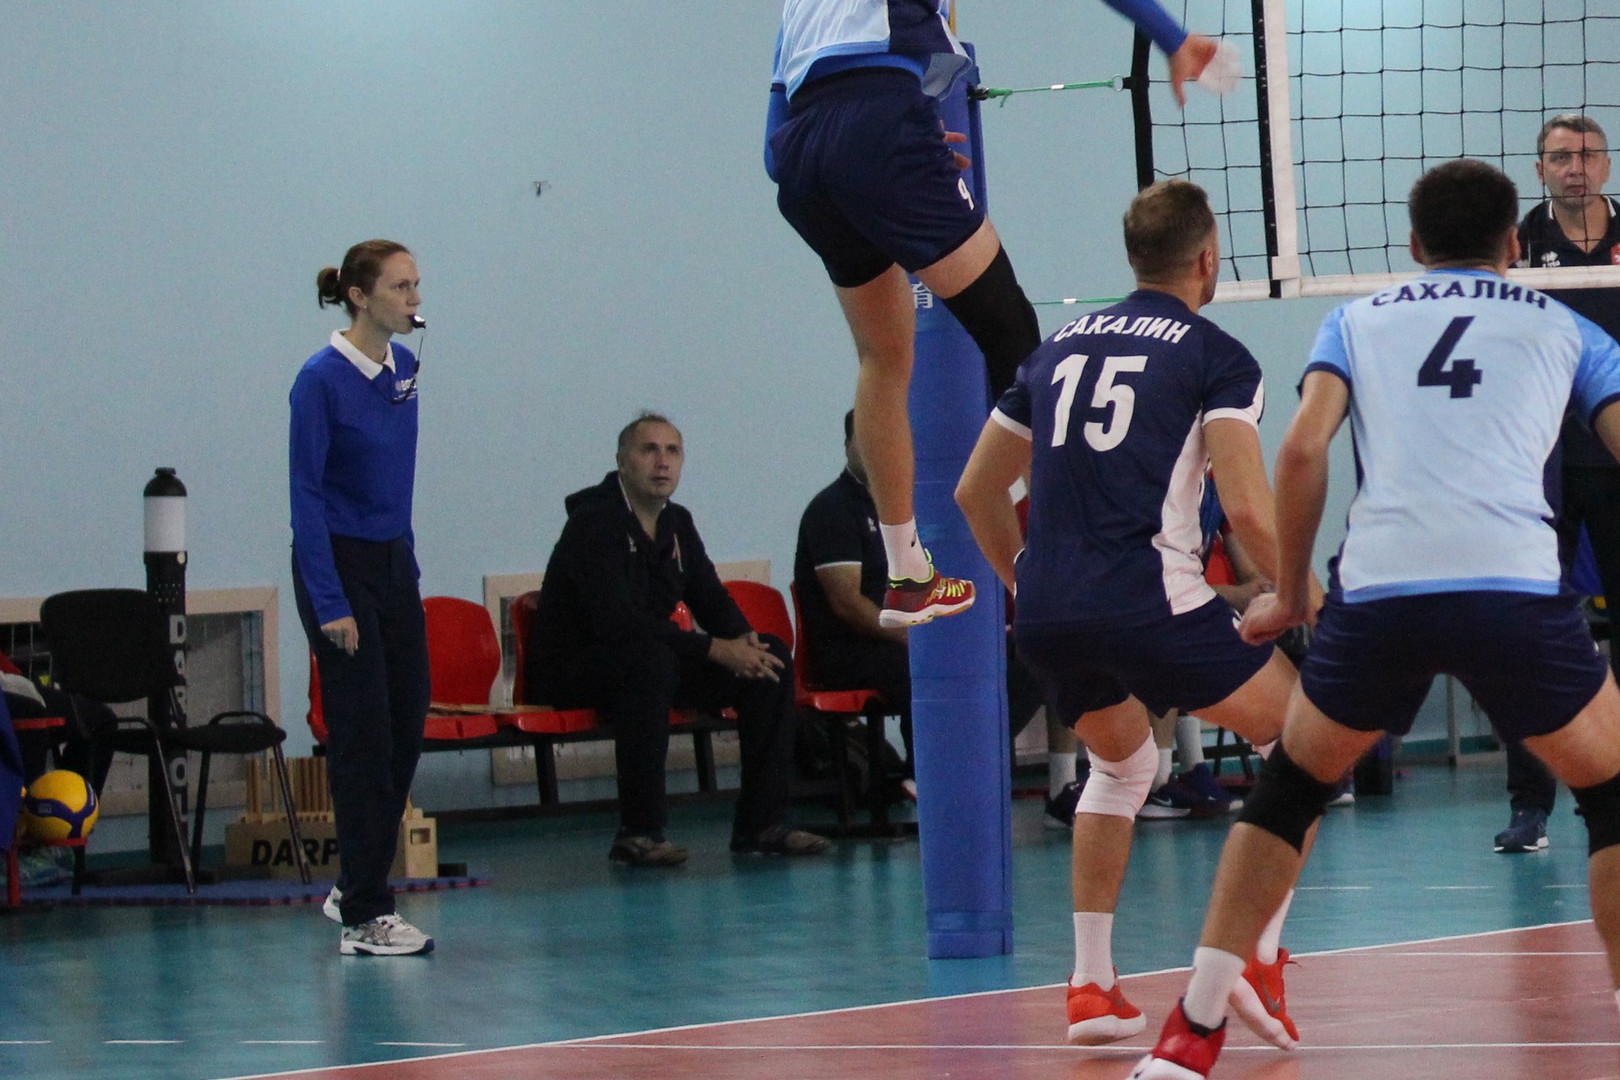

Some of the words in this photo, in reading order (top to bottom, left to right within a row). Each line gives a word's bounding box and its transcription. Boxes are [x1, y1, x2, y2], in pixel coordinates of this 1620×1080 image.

[1372, 279, 1548, 310] САХАЛИН
[1053, 314, 1192, 344] САХАЛИН
[1417, 315, 1484, 399] 4
[1050, 353, 1149, 452] 15
